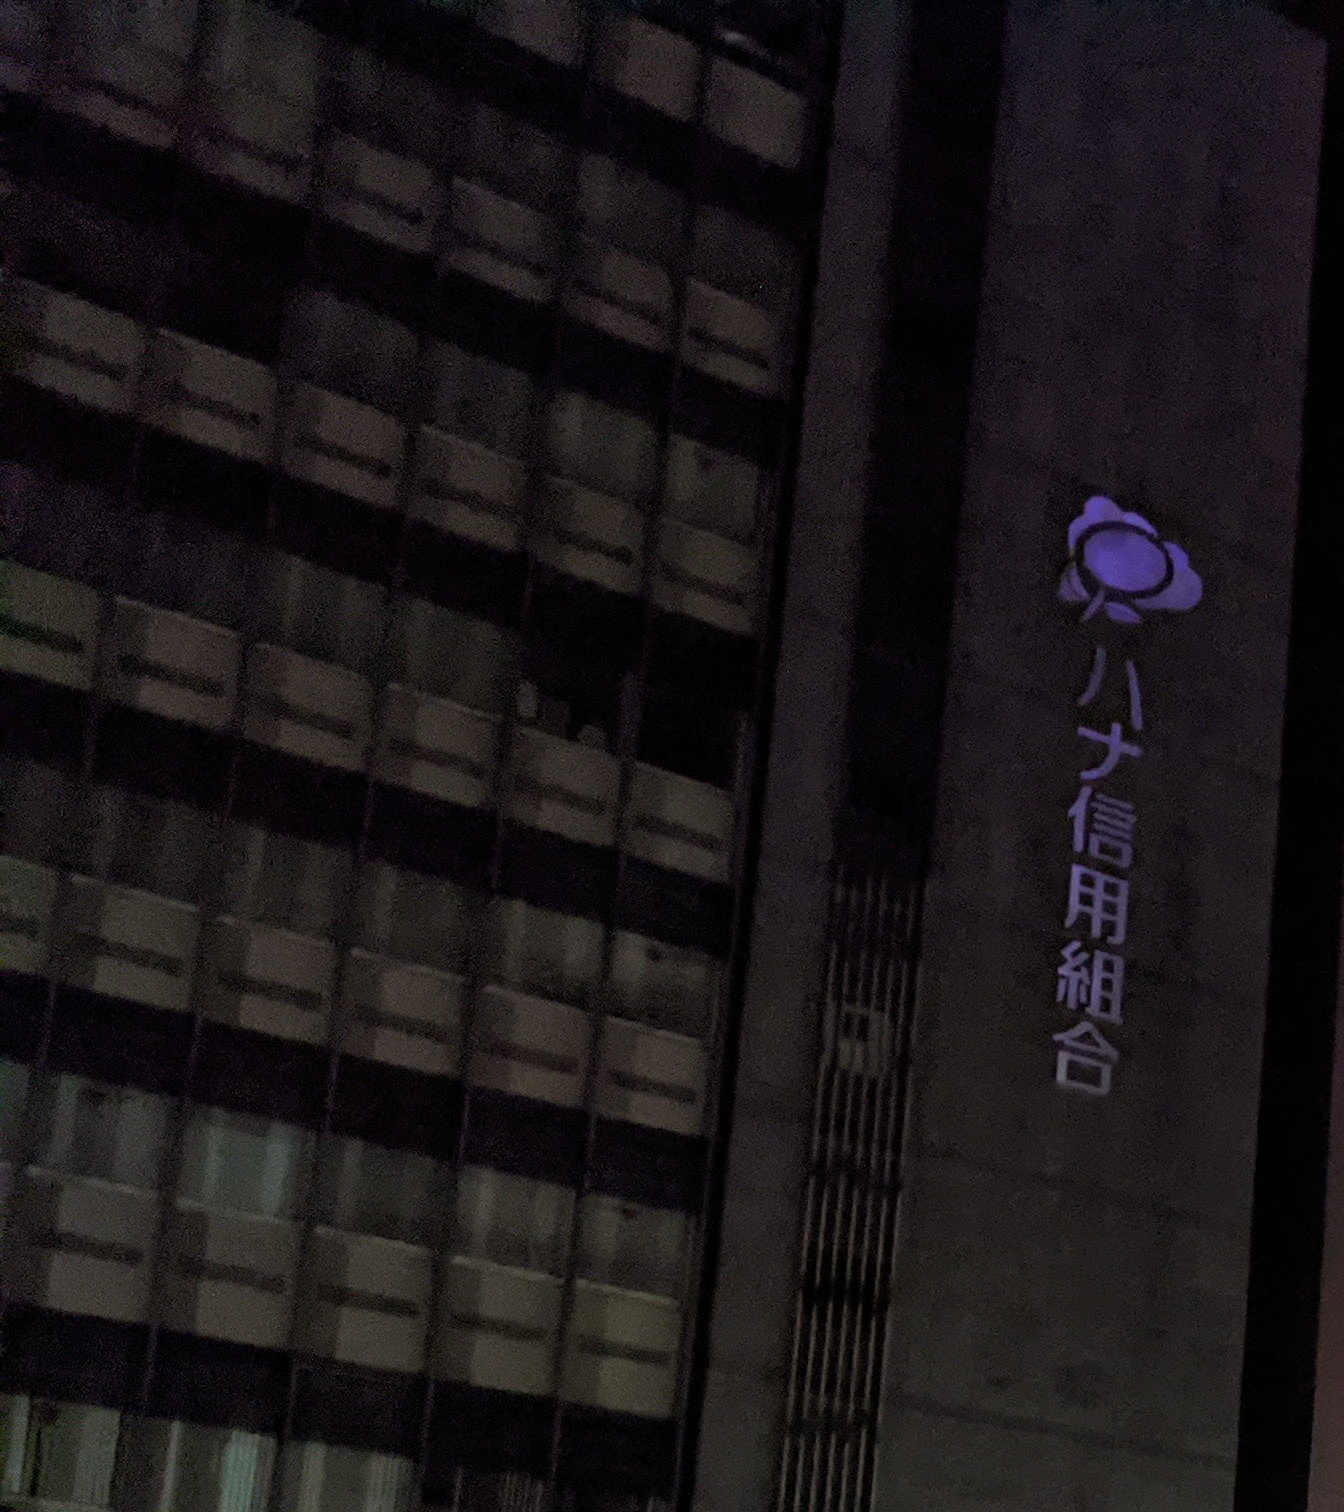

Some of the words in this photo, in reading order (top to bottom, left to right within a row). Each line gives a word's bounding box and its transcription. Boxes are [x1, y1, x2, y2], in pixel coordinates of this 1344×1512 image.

[1053, 647, 1143, 1097] ハナ信用組合
